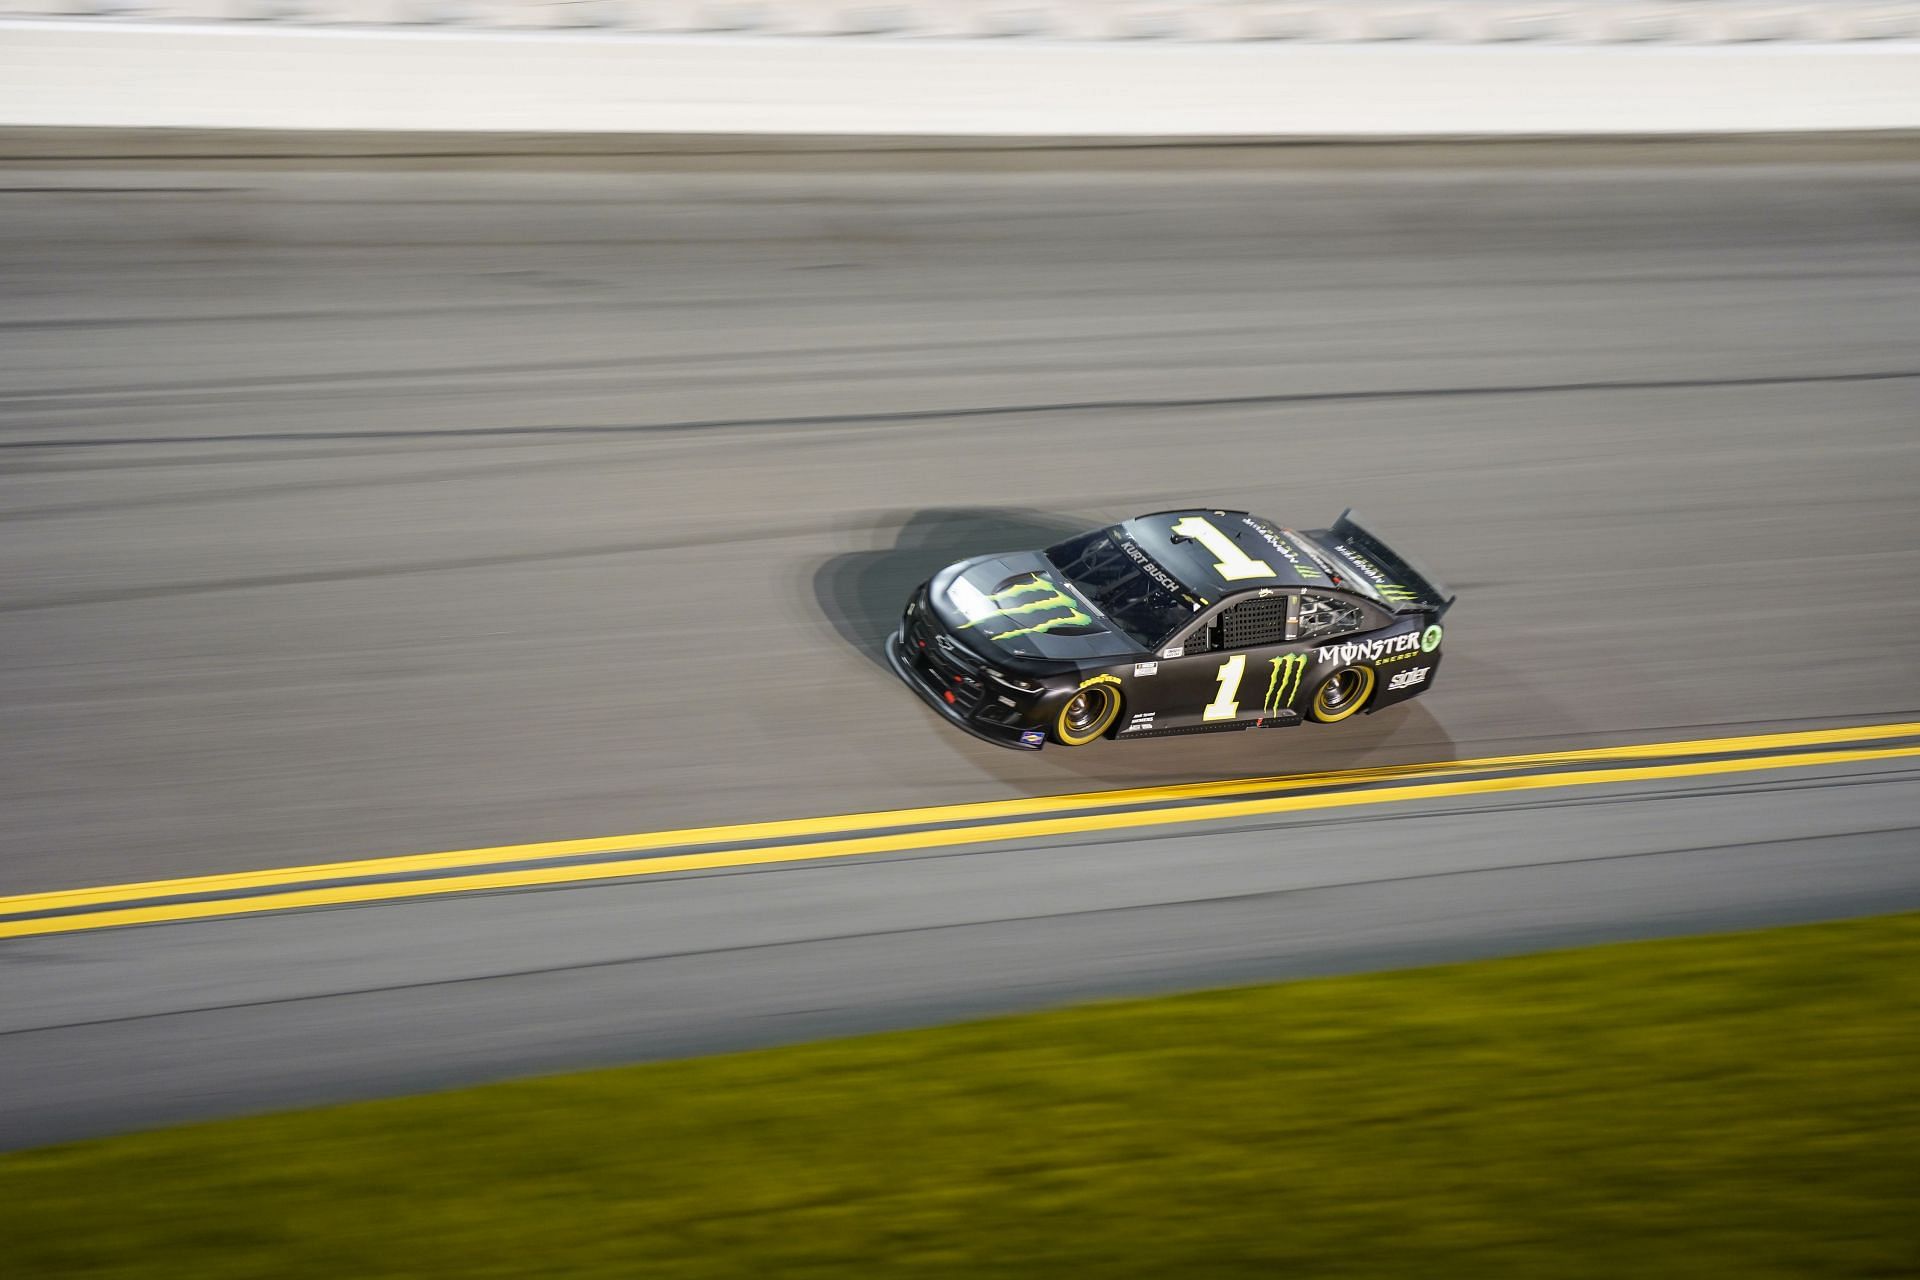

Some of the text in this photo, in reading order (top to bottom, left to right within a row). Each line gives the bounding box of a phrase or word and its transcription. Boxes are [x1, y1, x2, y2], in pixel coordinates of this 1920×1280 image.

[1121, 541, 1180, 592] KURT BUSCH
[1170, 516, 1277, 582] 1
[1317, 631, 1421, 665] MONSTER
[1375, 651, 1419, 666] ENERGY
[1202, 654, 1247, 722] 1
